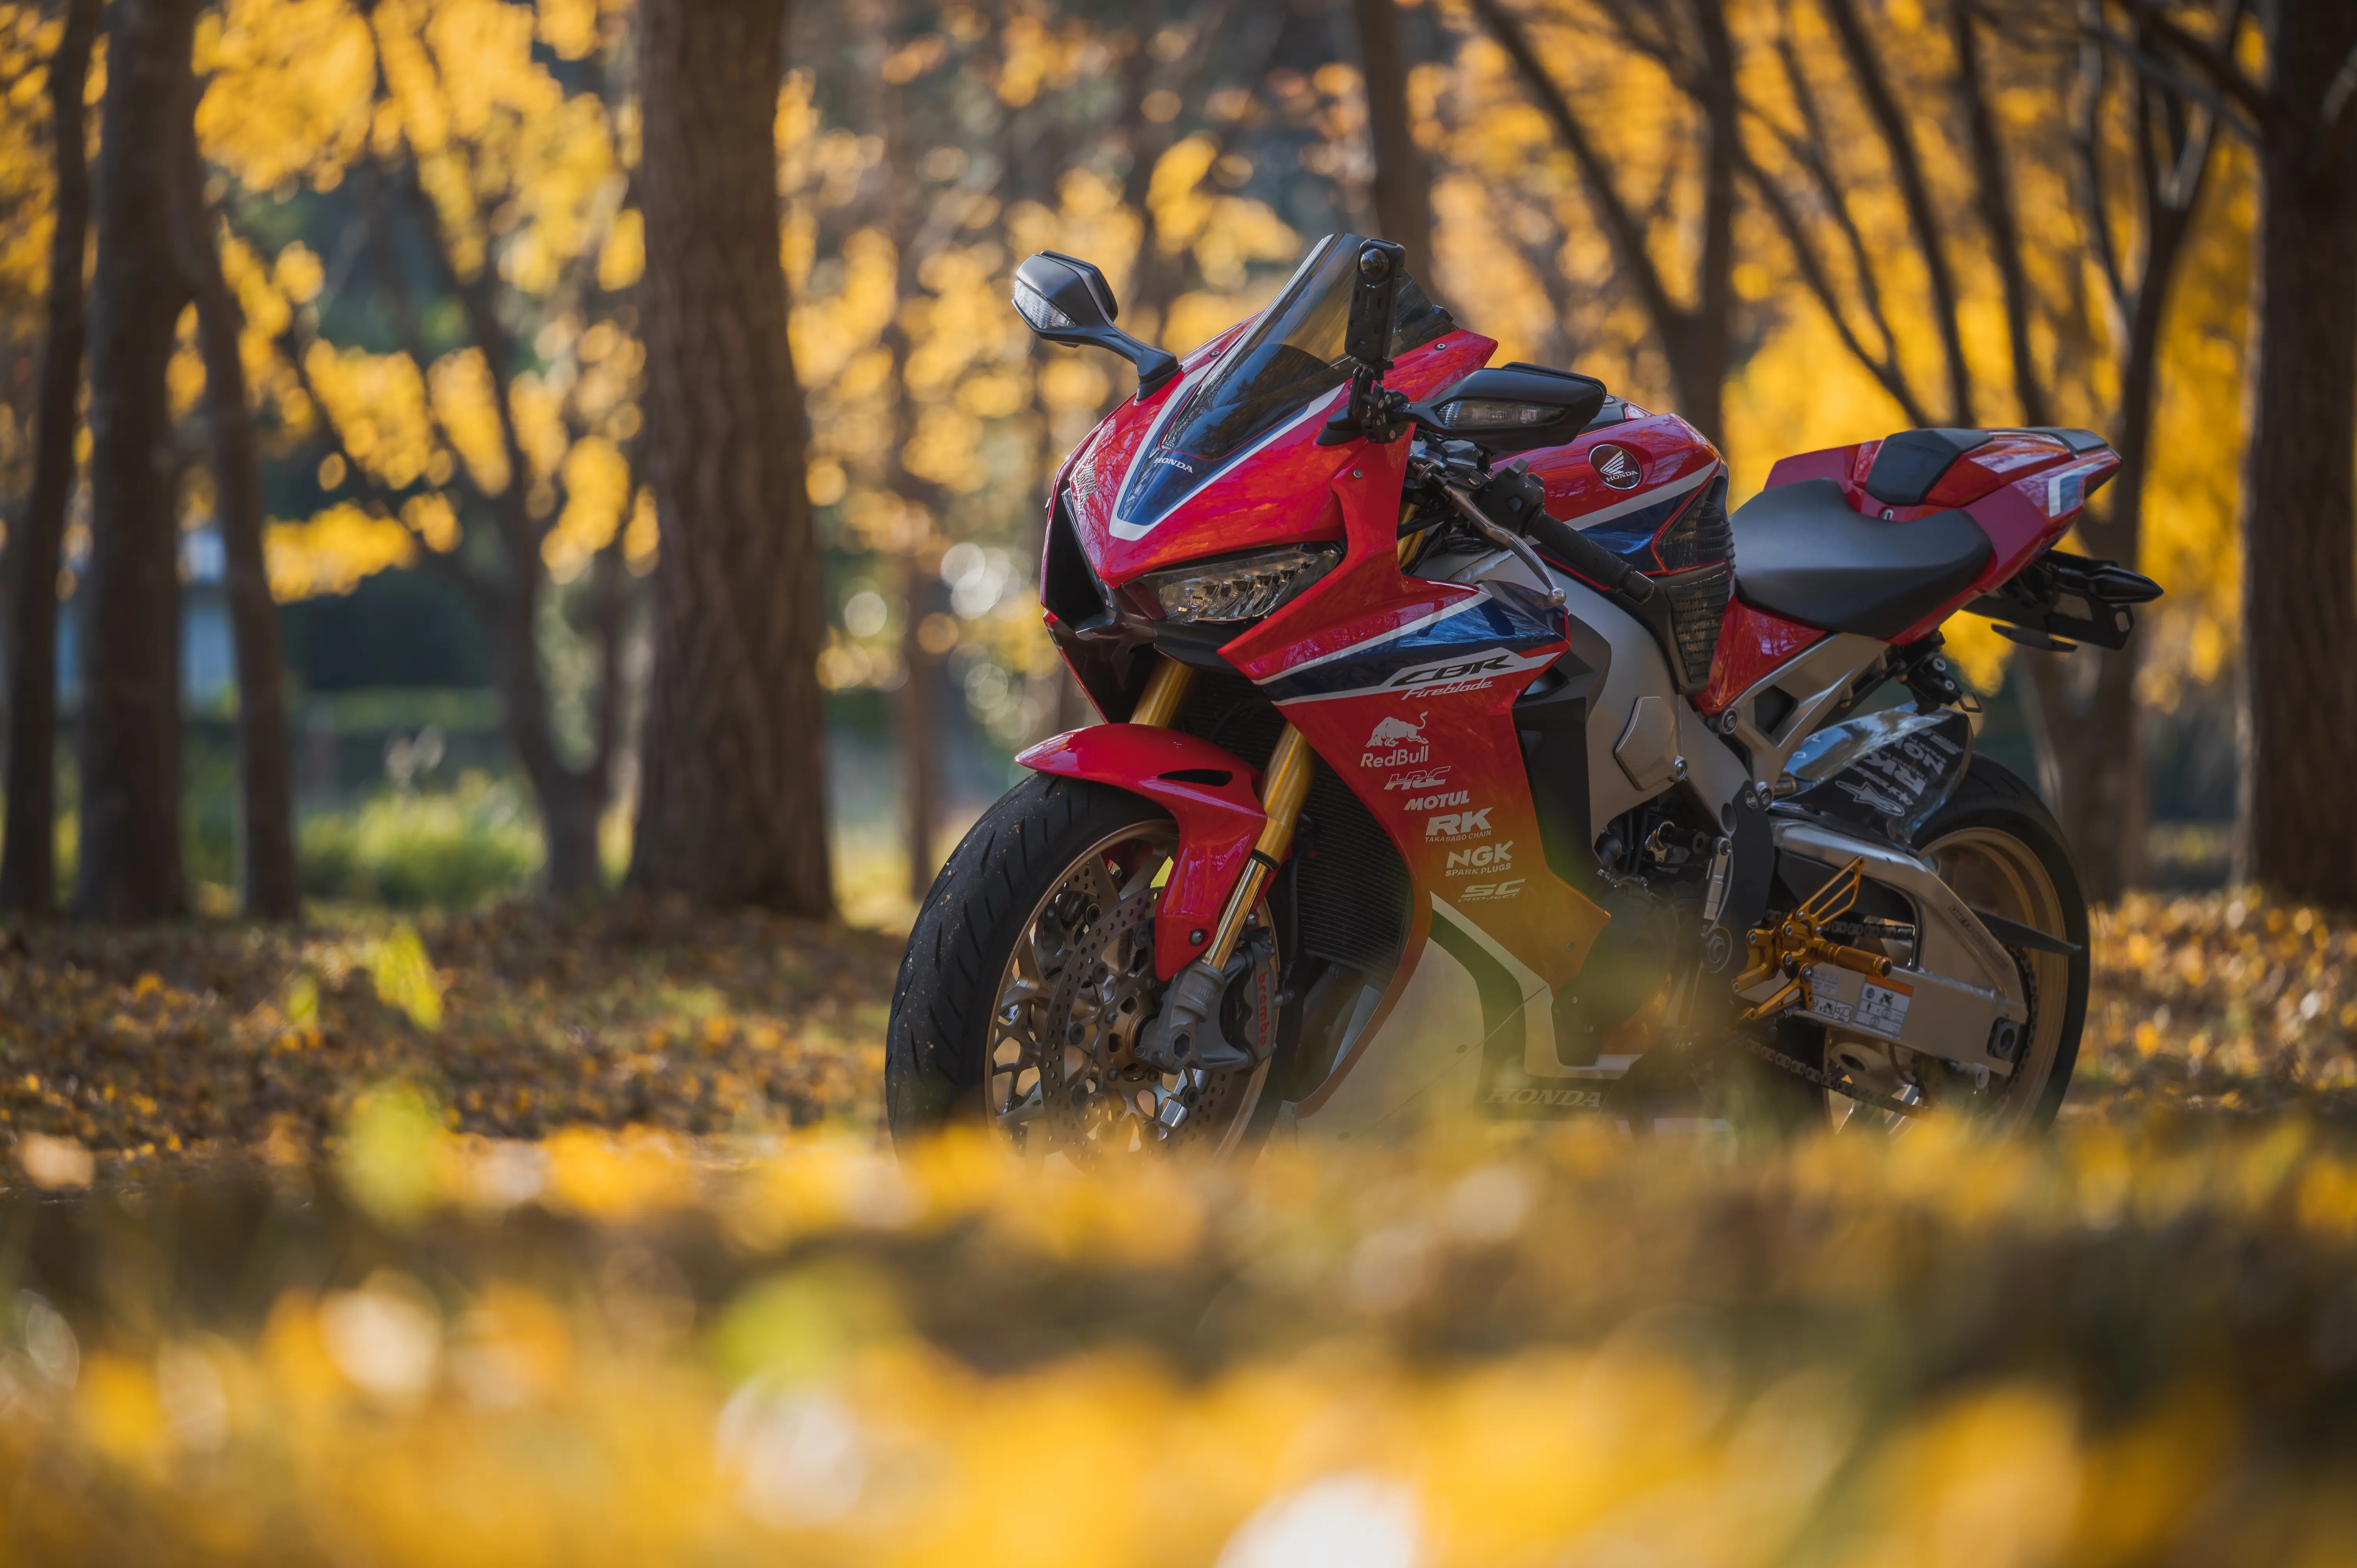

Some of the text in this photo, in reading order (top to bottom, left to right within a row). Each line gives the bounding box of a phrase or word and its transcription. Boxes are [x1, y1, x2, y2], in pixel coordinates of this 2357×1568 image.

[1154, 457, 1193, 473] HONDA
[1605, 470, 1638, 482] HONDA
[1390, 655, 1515, 687] CBR
[1401, 677, 1493, 701] Fireblade
[1384, 766, 1451, 790] HRC
[1403, 790, 1470, 811] MOTUL
[1426, 807, 1493, 836] RK
[1425, 830, 1491, 842] TAKASAGO CHAIN
[1447, 840, 1514, 869] NGK
[1445, 863, 1511, 877] SPARK PLUGS
[1458, 892, 1519, 903] PROJECT
[1461, 878, 1526, 897] SC
[1258, 971, 1270, 1046] brembo
[1484, 1089, 1601, 1107] HONDA
